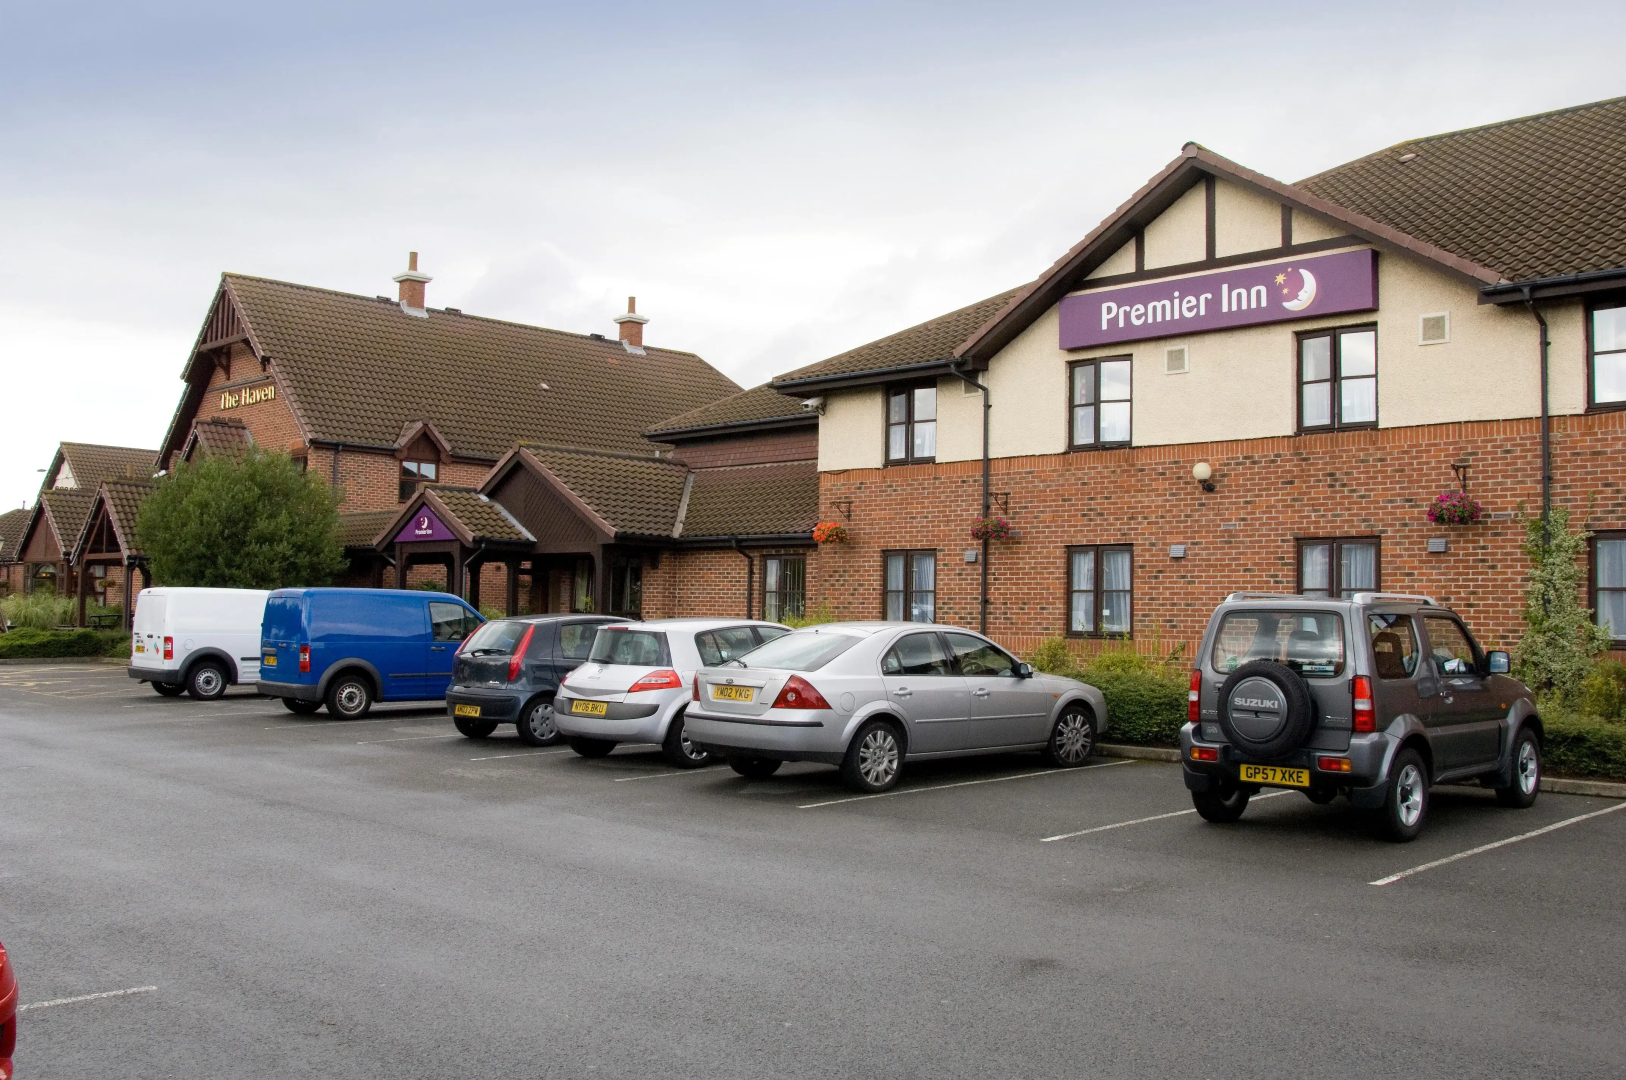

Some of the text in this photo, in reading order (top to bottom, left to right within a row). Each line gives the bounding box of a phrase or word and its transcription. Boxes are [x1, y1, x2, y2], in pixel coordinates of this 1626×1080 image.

[1101, 283, 1267, 330] Premier Inn
[220, 386, 275, 410] The Haven
[715, 686, 750, 699] YM02 YKG
[590, 703, 604, 713] BKU
[1234, 697, 1279, 709] SUZUKI
[1245, 766, 1305, 784] GP57 XKE
